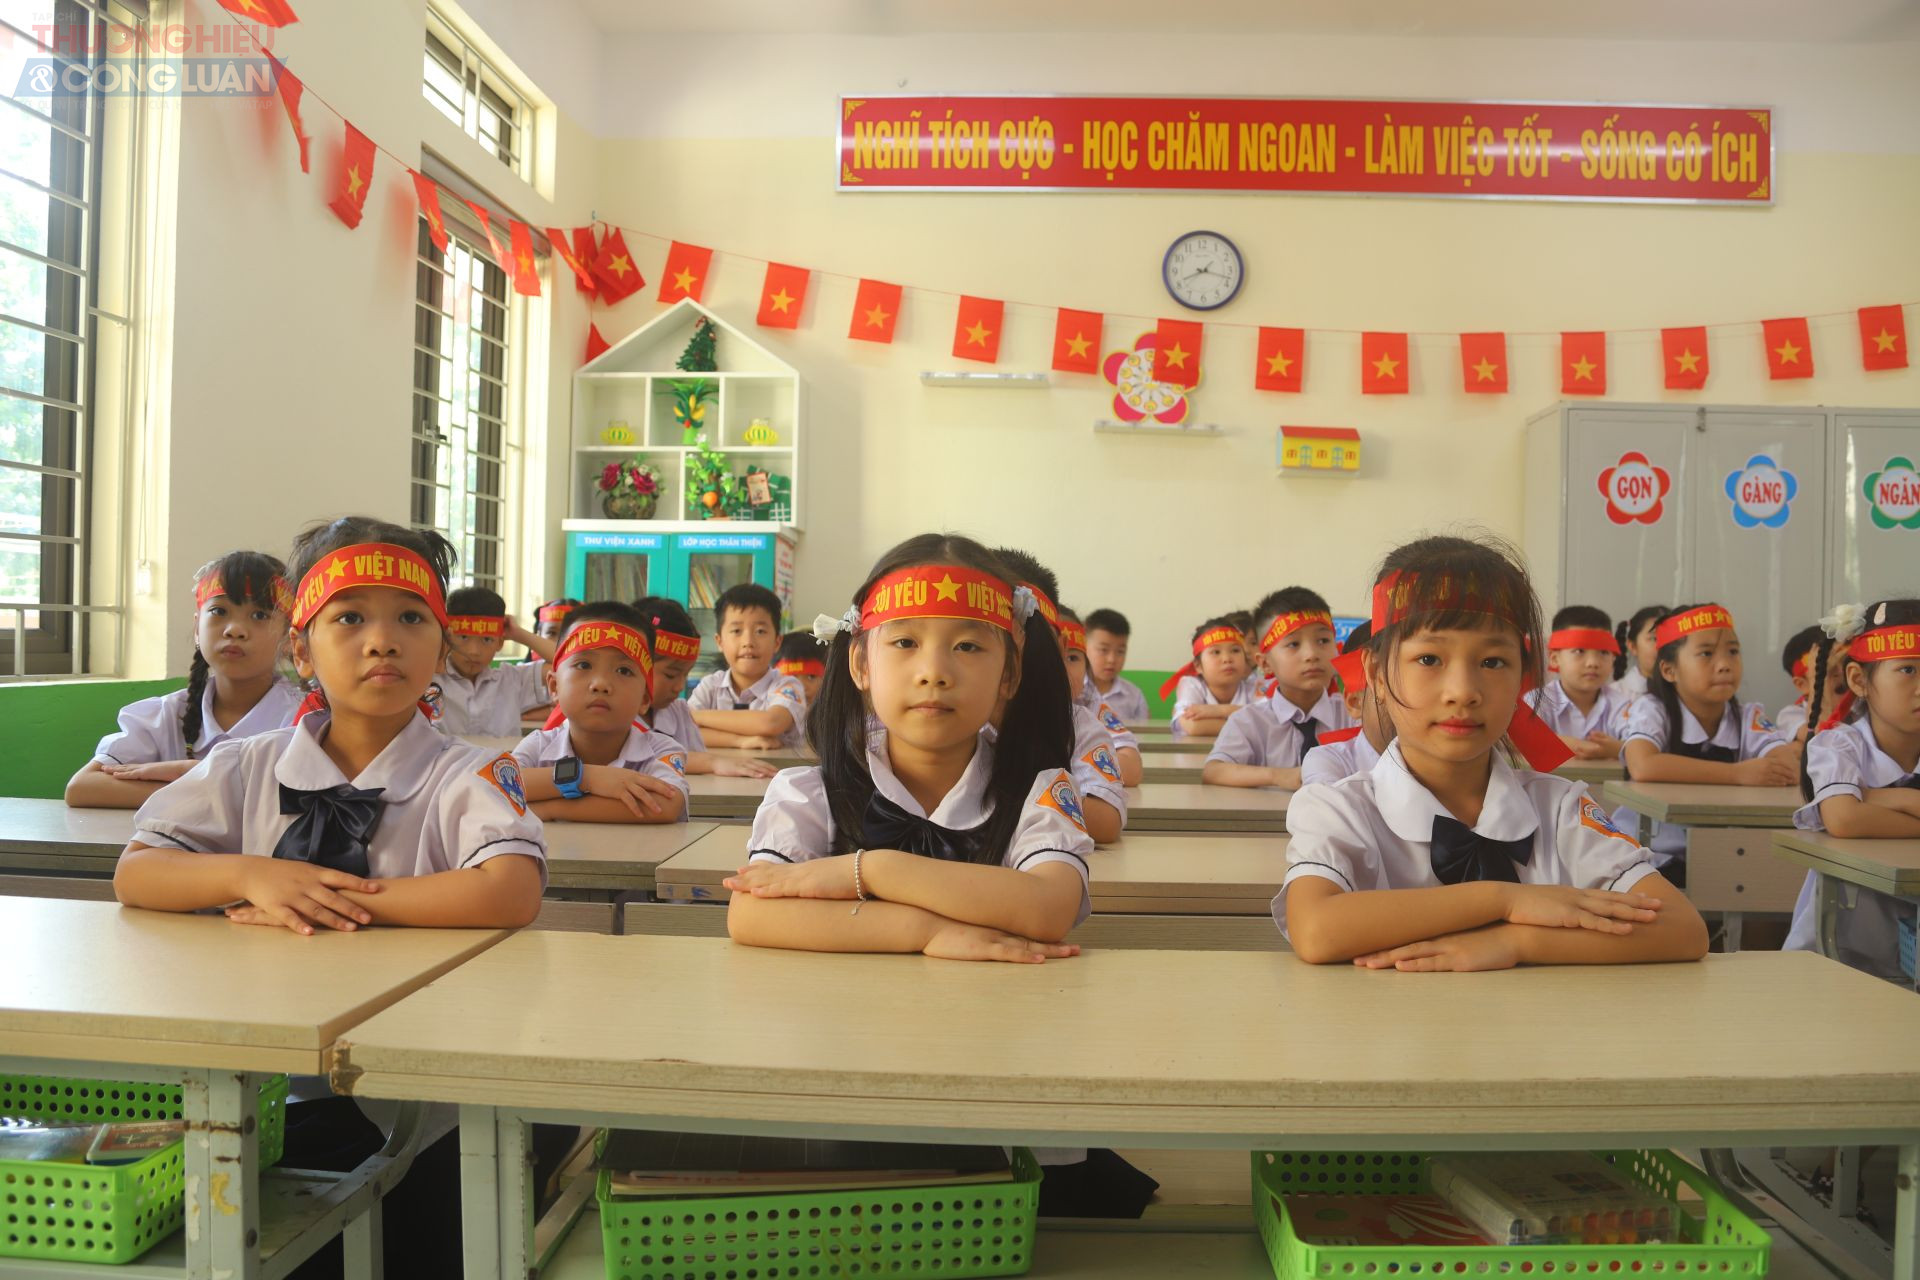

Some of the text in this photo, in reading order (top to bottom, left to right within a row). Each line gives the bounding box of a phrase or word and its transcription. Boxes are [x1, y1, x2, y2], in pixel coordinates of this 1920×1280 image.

[854, 110, 921, 169] NGHĨ
[928, 110, 989, 169] TÍCH
[999, 116, 1054, 179] CỰC
[1083, 120, 1138, 180] HỌC
[1148, 111, 1229, 171] CHĂM
[1239, 123, 1336, 172] NGOAN
[1365, 114, 1424, 174] LÀM
[1433, 116, 1494, 187] VIỆC
[1503, 113, 1552, 177] TỐT
[1581, 114, 1656, 180] SỐNG
[1665, 123, 1701, 182] CÓ
[1711, 121, 1757, 182] ÍCH
[1617, 476, 1652, 506] GỌN
[1742, 474, 1782, 504] GÀNG
[604, 535, 625, 547] VIỆN
[627, 538, 656, 547] XANH
[304, 573, 325, 611] YÊU
[354, 551, 394, 580] VIỆT
[398, 558, 430, 595] NAM
[894, 577, 927, 608] YÊU
[966, 581, 995, 616] VIỆT
[1693, 611, 1713, 627] YÊU
[578, 627, 601, 646] YÊU
[1867, 630, 1915, 653] TÔI YÊU
